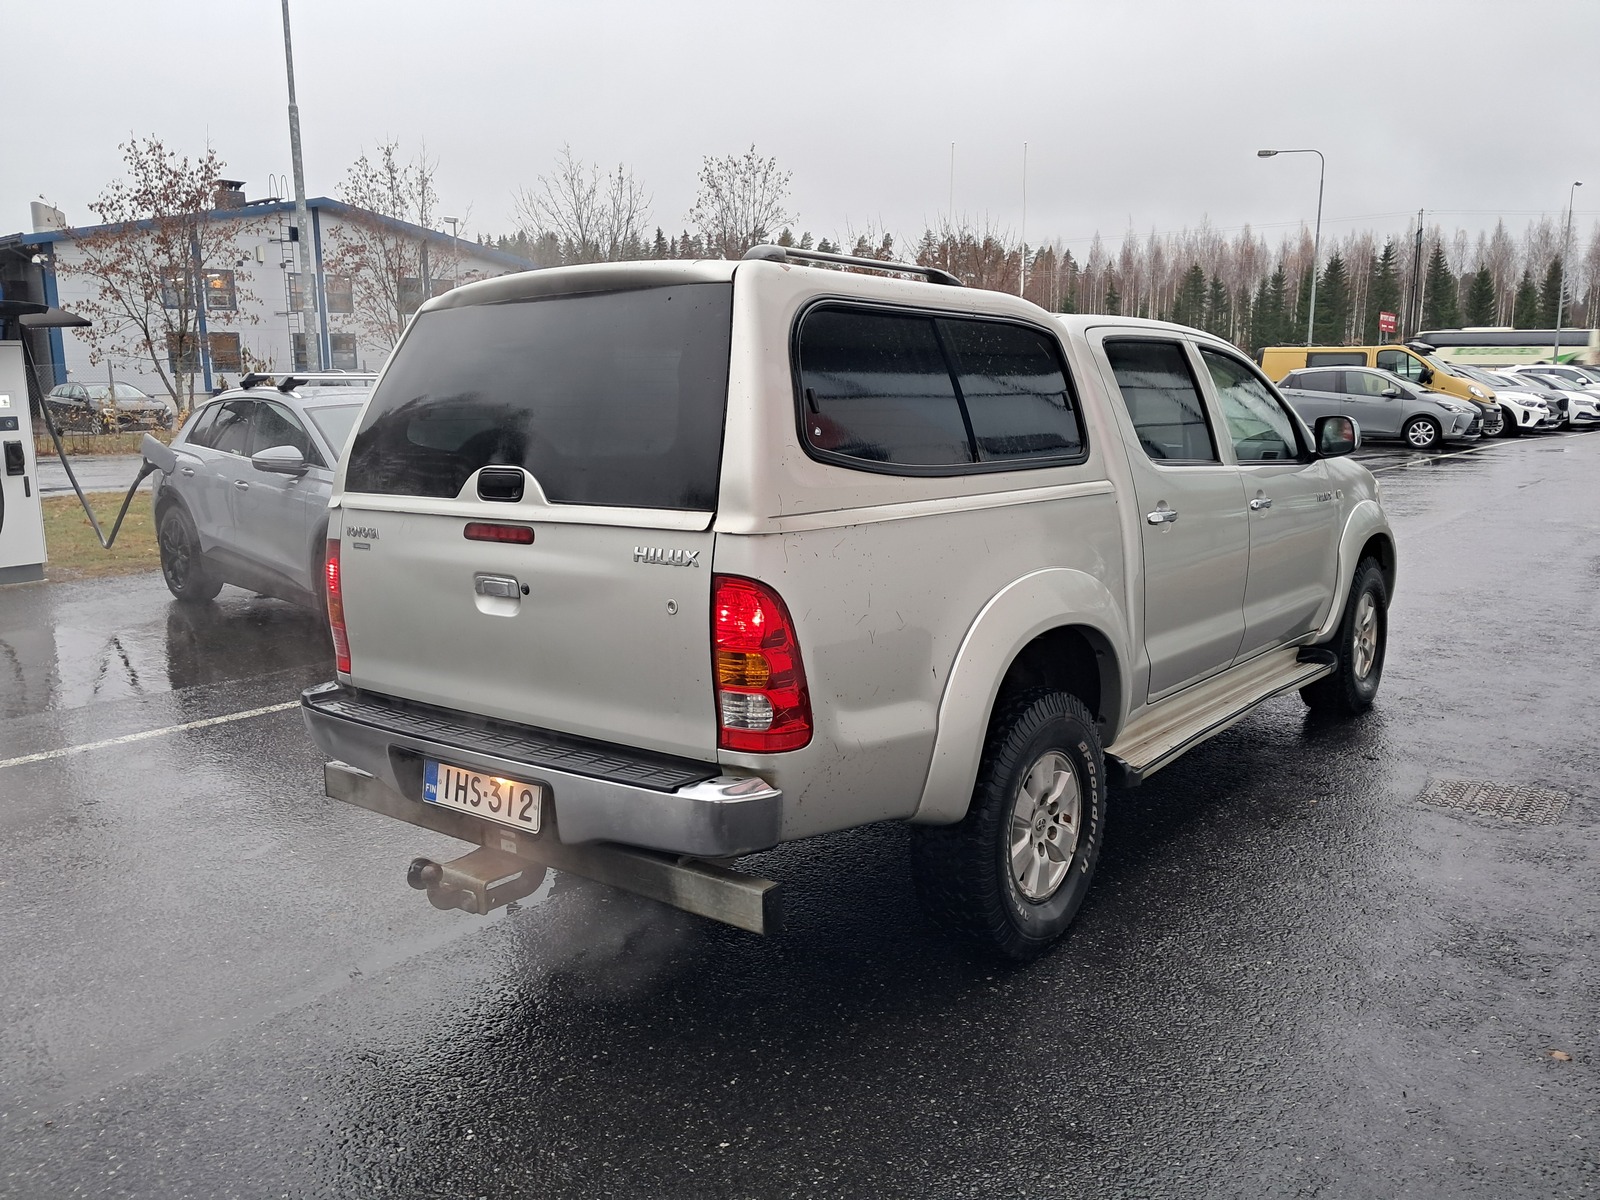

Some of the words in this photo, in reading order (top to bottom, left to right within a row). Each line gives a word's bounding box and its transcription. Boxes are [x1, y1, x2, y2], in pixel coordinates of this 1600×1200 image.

[633, 546, 700, 568] HILUX
[425, 782, 437, 794] FIN
[444, 768, 533, 822] IHS-312
